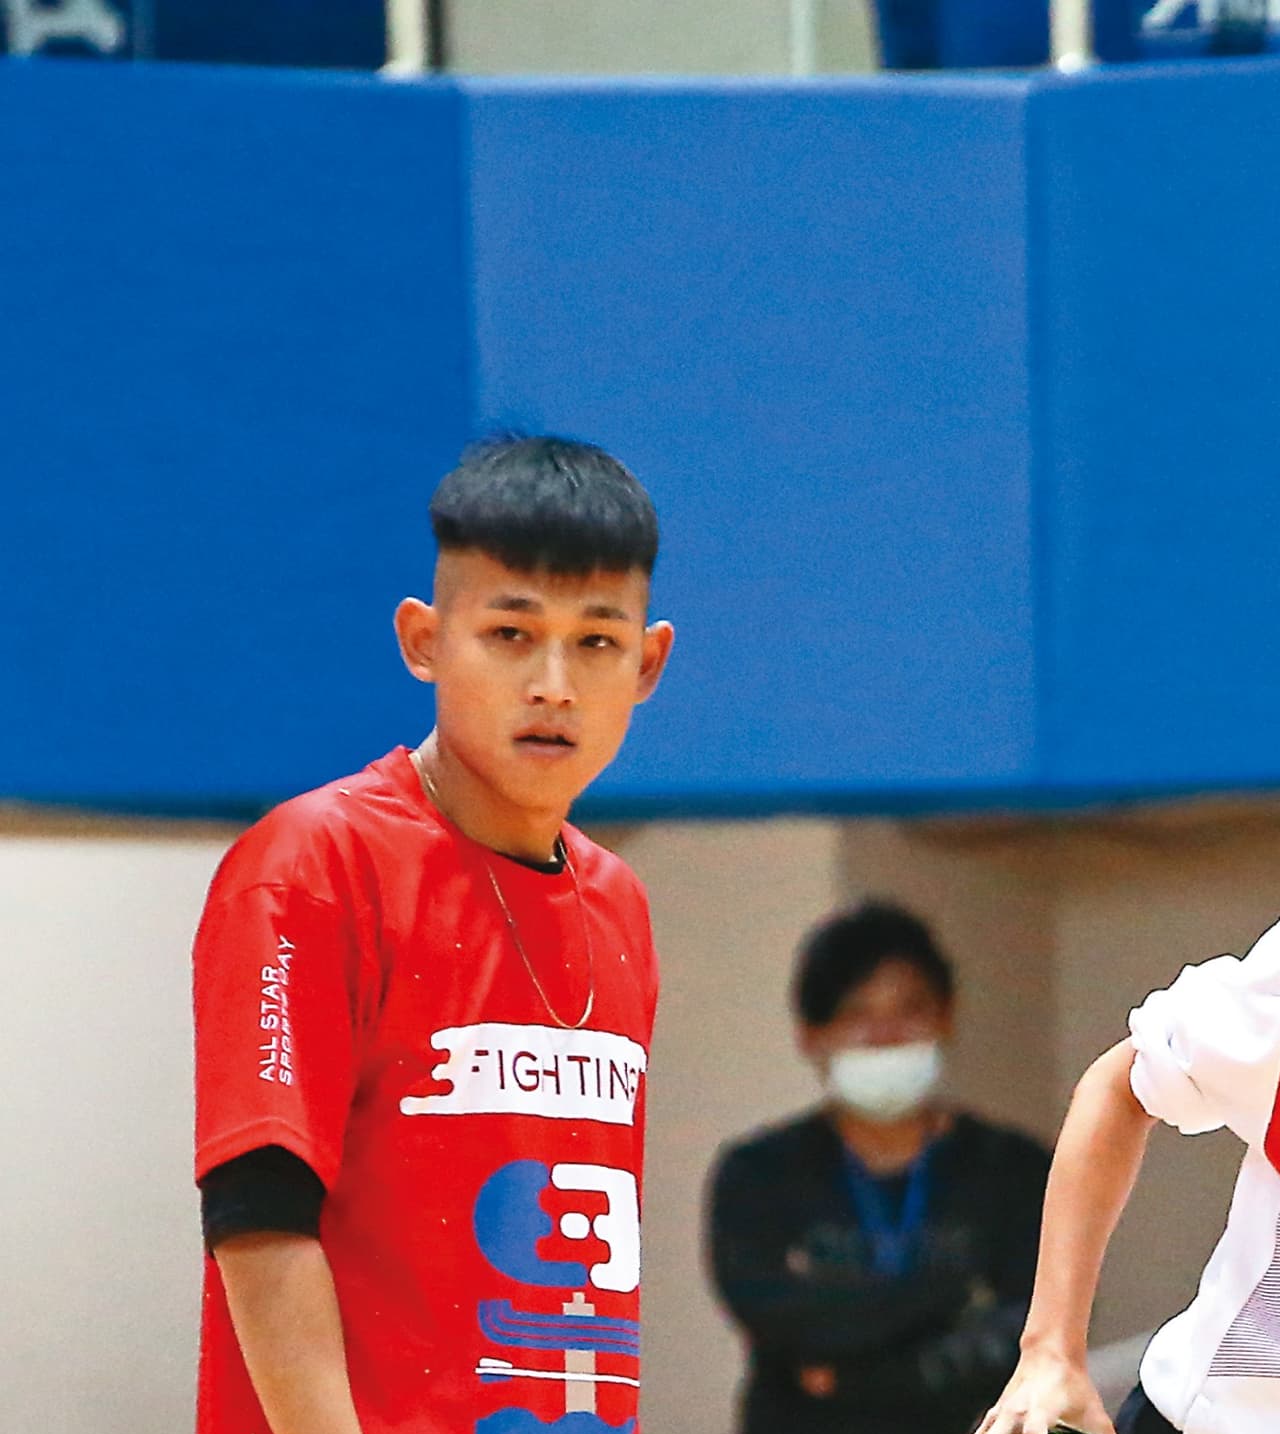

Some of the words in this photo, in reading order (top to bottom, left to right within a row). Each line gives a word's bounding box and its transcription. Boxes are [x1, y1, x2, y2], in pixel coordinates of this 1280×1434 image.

[260, 965, 281, 1030] STAR
[258, 1035, 277, 1081] ALL
[471, 1049, 640, 1102] FIGHTIN
